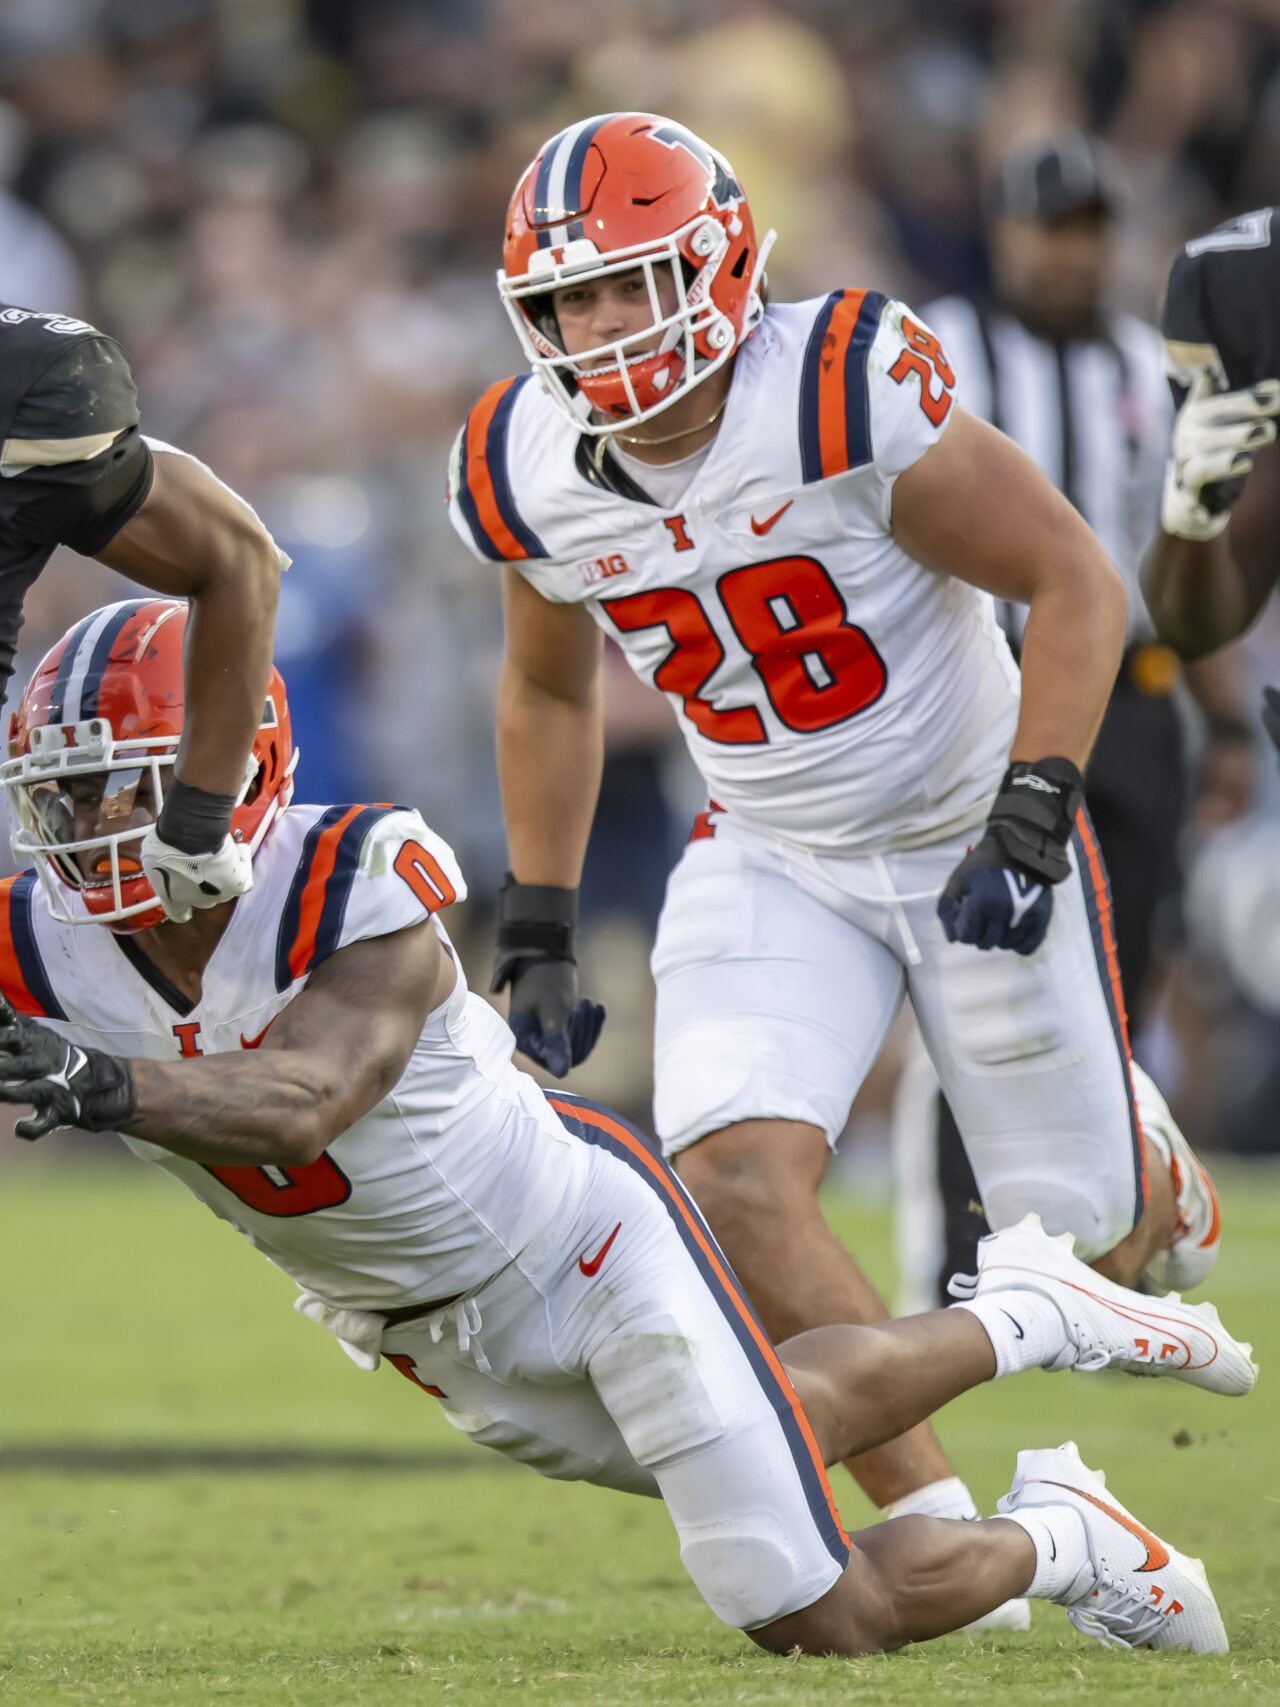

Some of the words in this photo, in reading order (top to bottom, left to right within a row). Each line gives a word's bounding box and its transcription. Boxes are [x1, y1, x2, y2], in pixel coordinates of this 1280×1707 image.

[886, 315, 956, 429] 28
[664, 514, 695, 552] I
[598, 555, 888, 745] 28
[61, 726, 79, 748] I
[393, 838, 457, 917] 0
[172, 1022, 204, 1059] I
